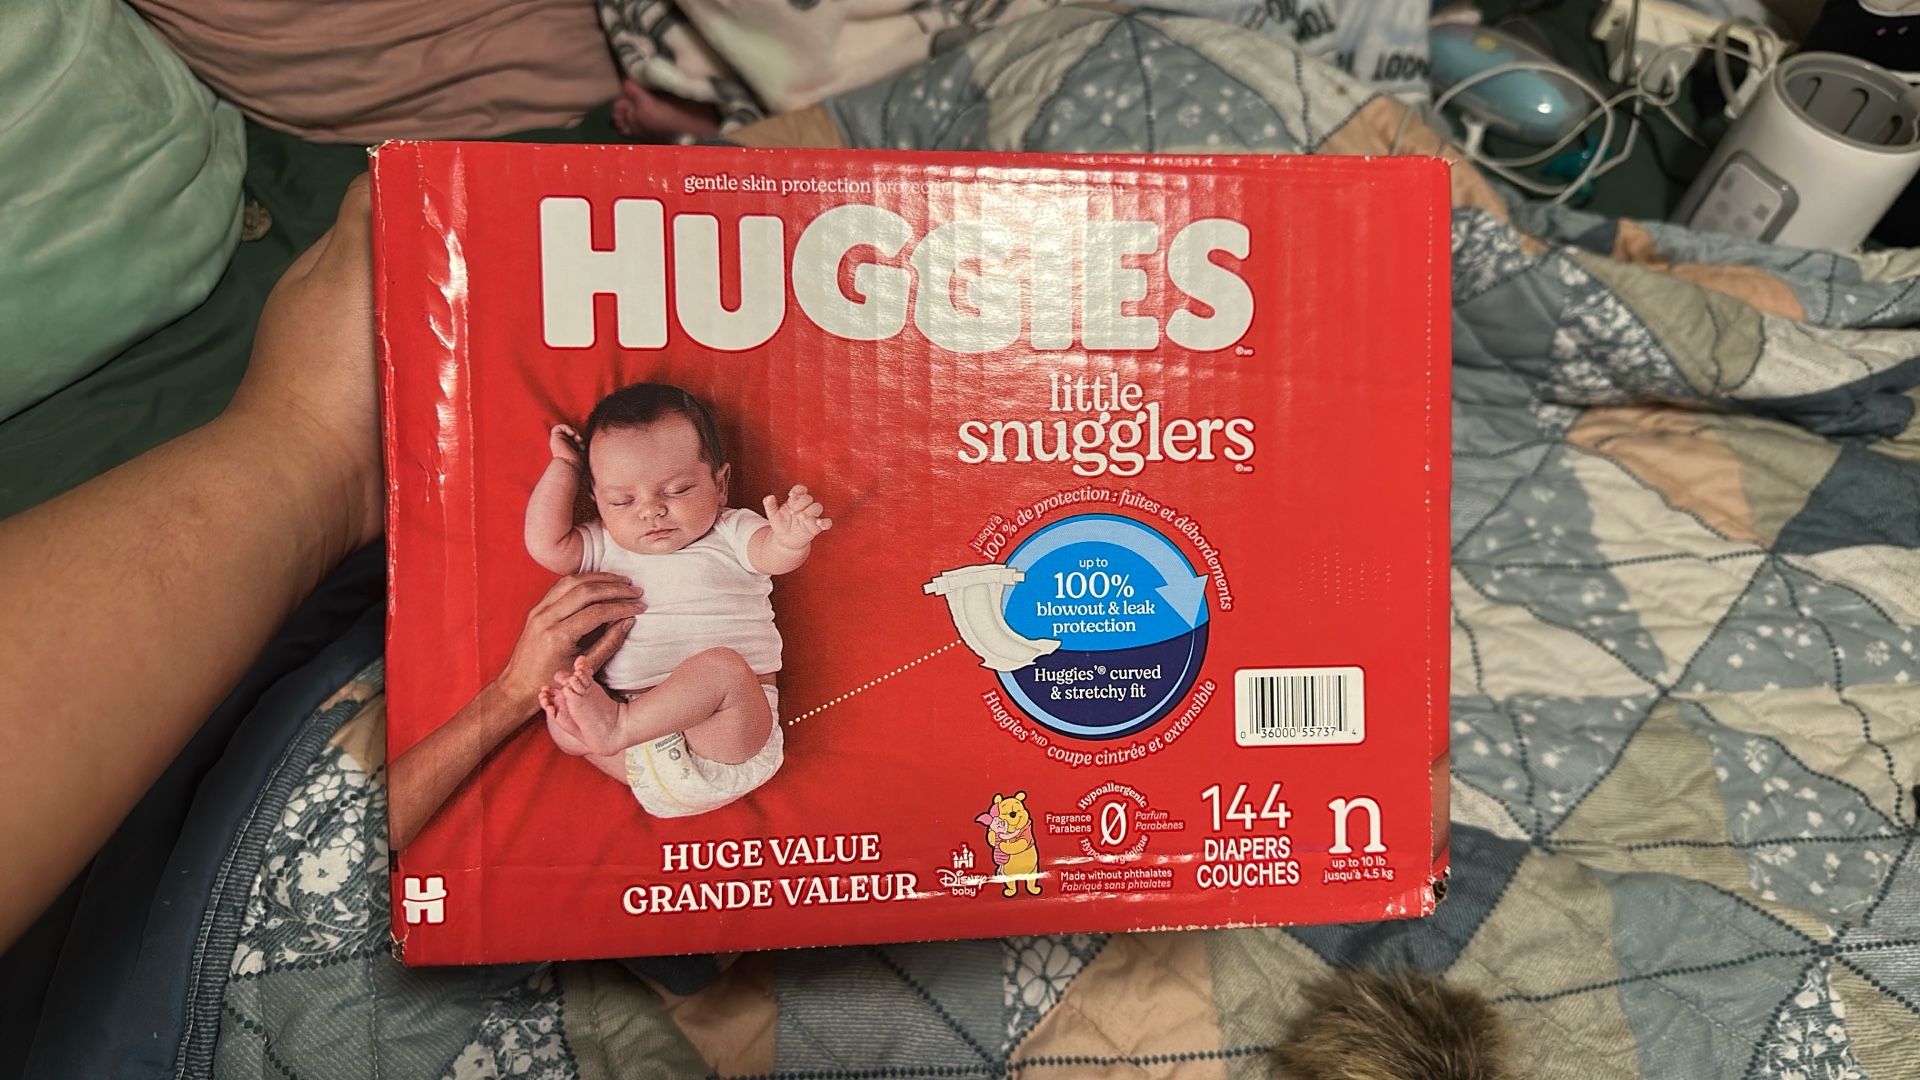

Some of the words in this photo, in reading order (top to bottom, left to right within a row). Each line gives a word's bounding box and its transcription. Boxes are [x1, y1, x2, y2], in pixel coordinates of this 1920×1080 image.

[684, 175, 738, 193] gentle
[742, 176, 777, 192] skin
[781, 178, 871, 196] protection
[540, 197, 1255, 352] HUGGIES
[1050, 371, 1143, 412] little
[957, 402, 1255, 476] snugglers
[983, 532, 1006, 561] 100
[1016, 510, 1034, 526] de
[1034, 486, 1109, 518] protection
[1119, 489, 1160, 514] fuites
[1160, 508, 1176, 522] et
[1174, 515, 1232, 611] débordements
[1079, 559, 1093, 570] up
[1096, 557, 1108, 567] to
[1054, 571, 1134, 599] 100%
[1036, 602, 1105, 616] blowout
[1108, 602, 1119, 615] &
[1123, 600, 1155, 614] leak
[1052, 618, 1136, 636] protection
[1109, 664, 1161, 680] curved
[1050, 686, 1061, 700] &
[1065, 684, 1127, 701] stretchy
[1130, 683, 1146, 698] fit
[1047, 746, 1092, 767] coupe
[1095, 743, 1146, 765] cintrée
[1148, 736, 1164, 752] et
[1164, 680, 1216, 743] extensible
[1261, 729, 1296, 738] 36000
[1302, 727, 1336, 737] 55737
[1078, 783, 1147, 810] Hypoallergenic
[1135, 811, 1168, 820] Parfum
[1202, 783, 1291, 831] 144
[1046, 814, 1092, 825] Fragrance
[1049, 824, 1092, 833] Parabens
[1135, 821, 1184, 831] Parabènes
[1328, 797, 1387, 854] n
[662, 840, 764, 872] HUGE
[768, 834, 880, 865] VALUE
[1080, 834, 1149, 865] Hypoargénique
[1204, 836, 1290, 861] DIAPERS
[1332, 859, 1345, 868] up
[1349, 858, 1359, 867] to
[1361, 857, 1372, 867] 10
[1376, 856, 1386, 866] lb
[1060, 872, 1085, 881] Made
[1088, 871, 1121, 879] without
[1124, 869, 1172, 880] phthalates
[1196, 861, 1299, 887] COUCHES
[1363, 869, 1379, 880] 4.5
[1381, 868, 1394, 880] kg
[622, 879, 772, 915] GRANDE
[780, 872, 918, 906] VALEUR
[952, 887, 977, 897] baby
[1061, 882, 1102, 892] Fabriqué
[1105, 882, 1125, 890] sans
[1127, 880, 1172, 891] phtalates
